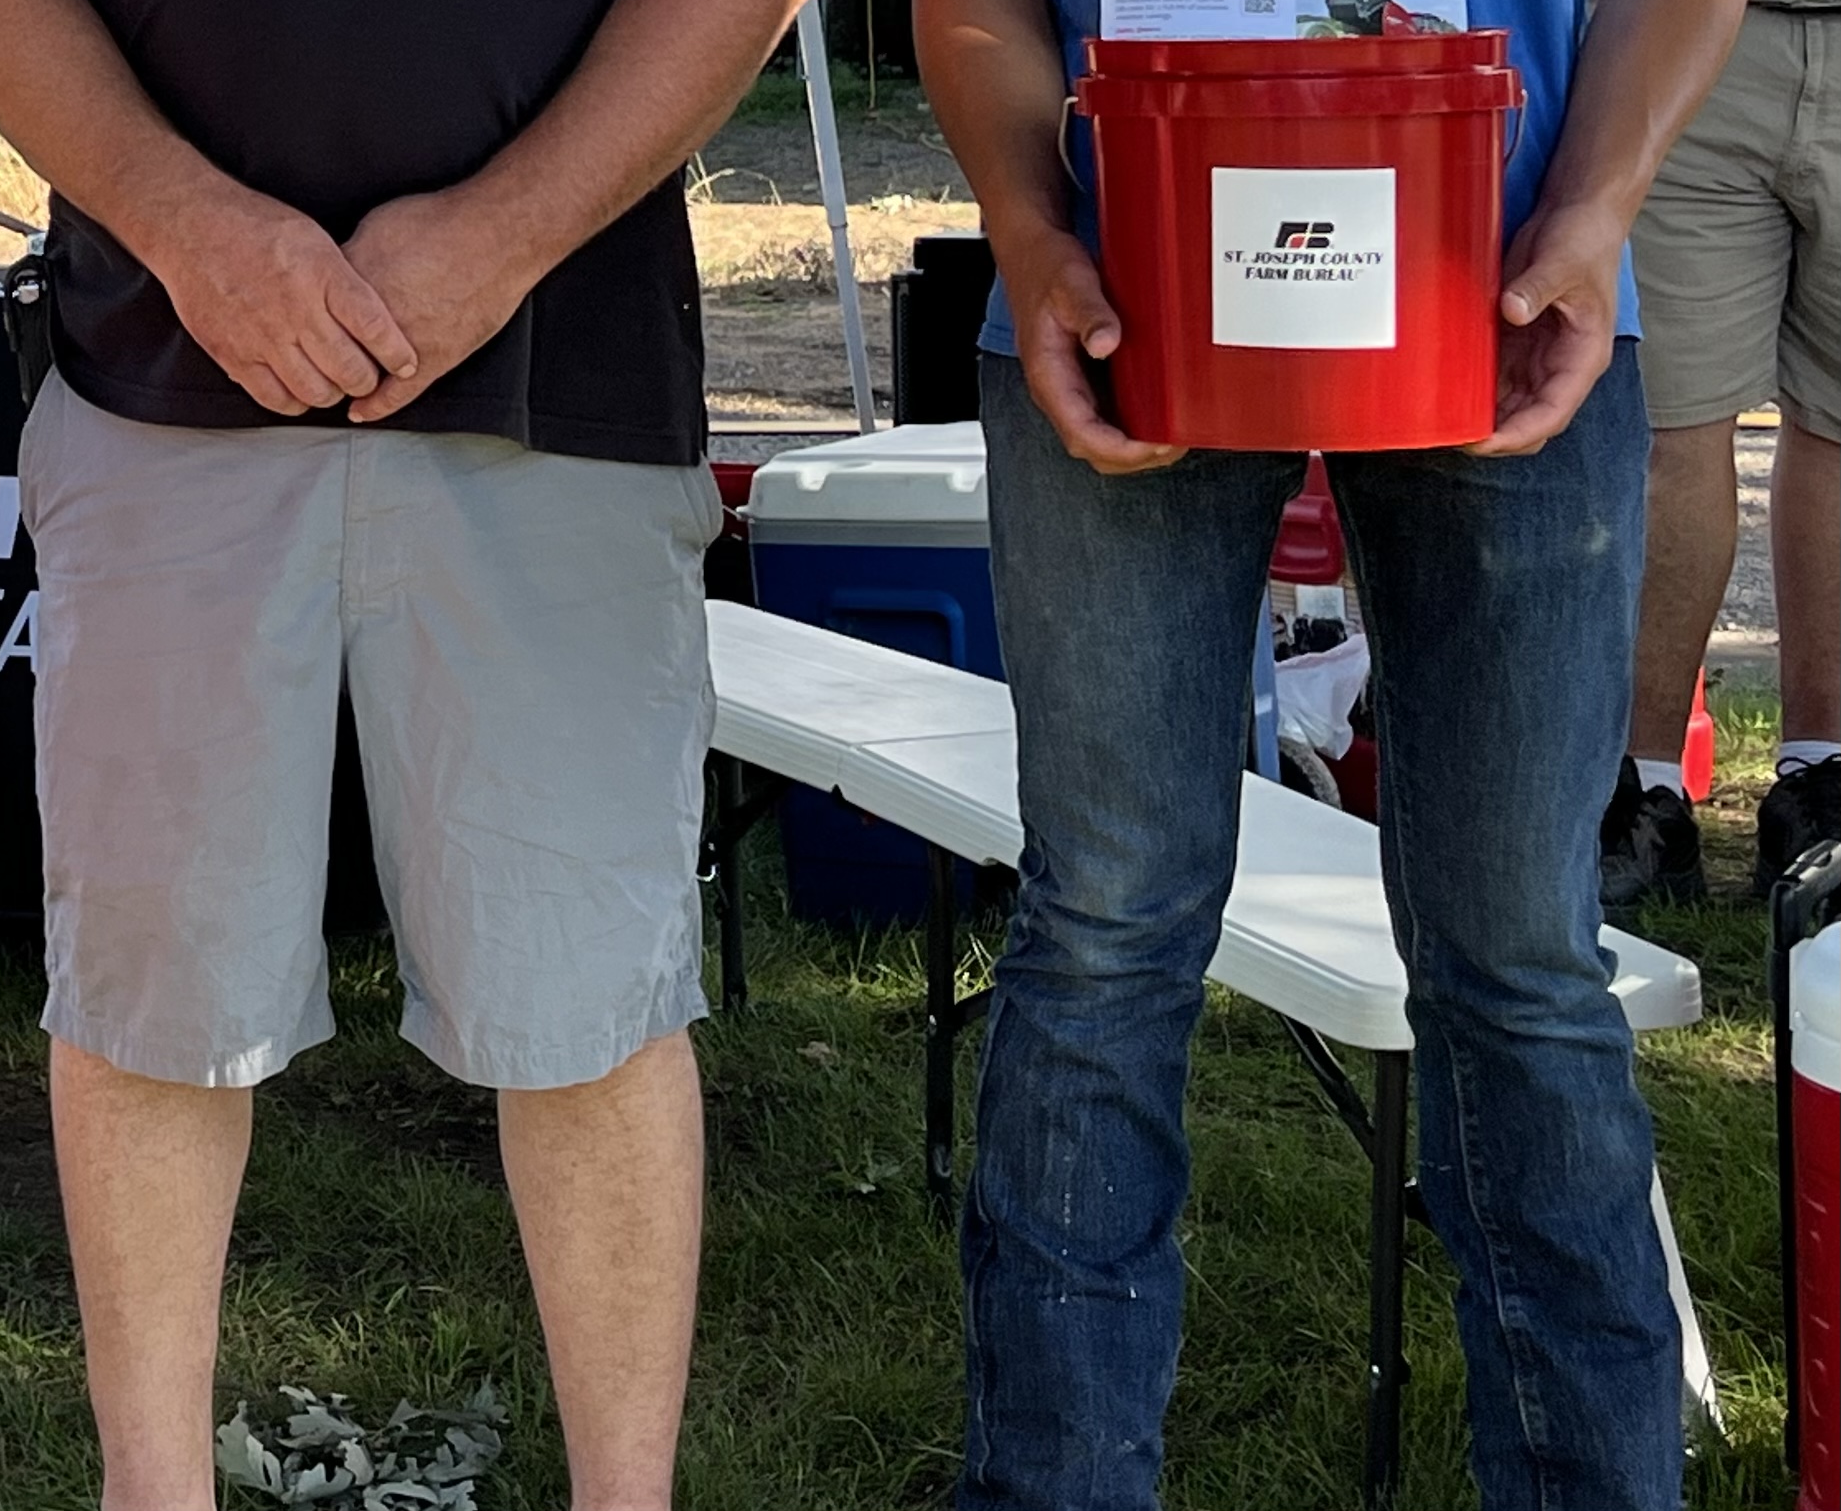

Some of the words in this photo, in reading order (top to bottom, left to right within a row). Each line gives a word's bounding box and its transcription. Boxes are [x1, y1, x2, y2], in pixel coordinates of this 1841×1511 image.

[1223, 250, 1247, 264] ST.
[1251, 252, 1316, 265] JOSEPH
[1320, 252, 1384, 265] COUNTY
[1244, 267, 1289, 280] FARM
[1292, 268, 1356, 281] BUREAU
